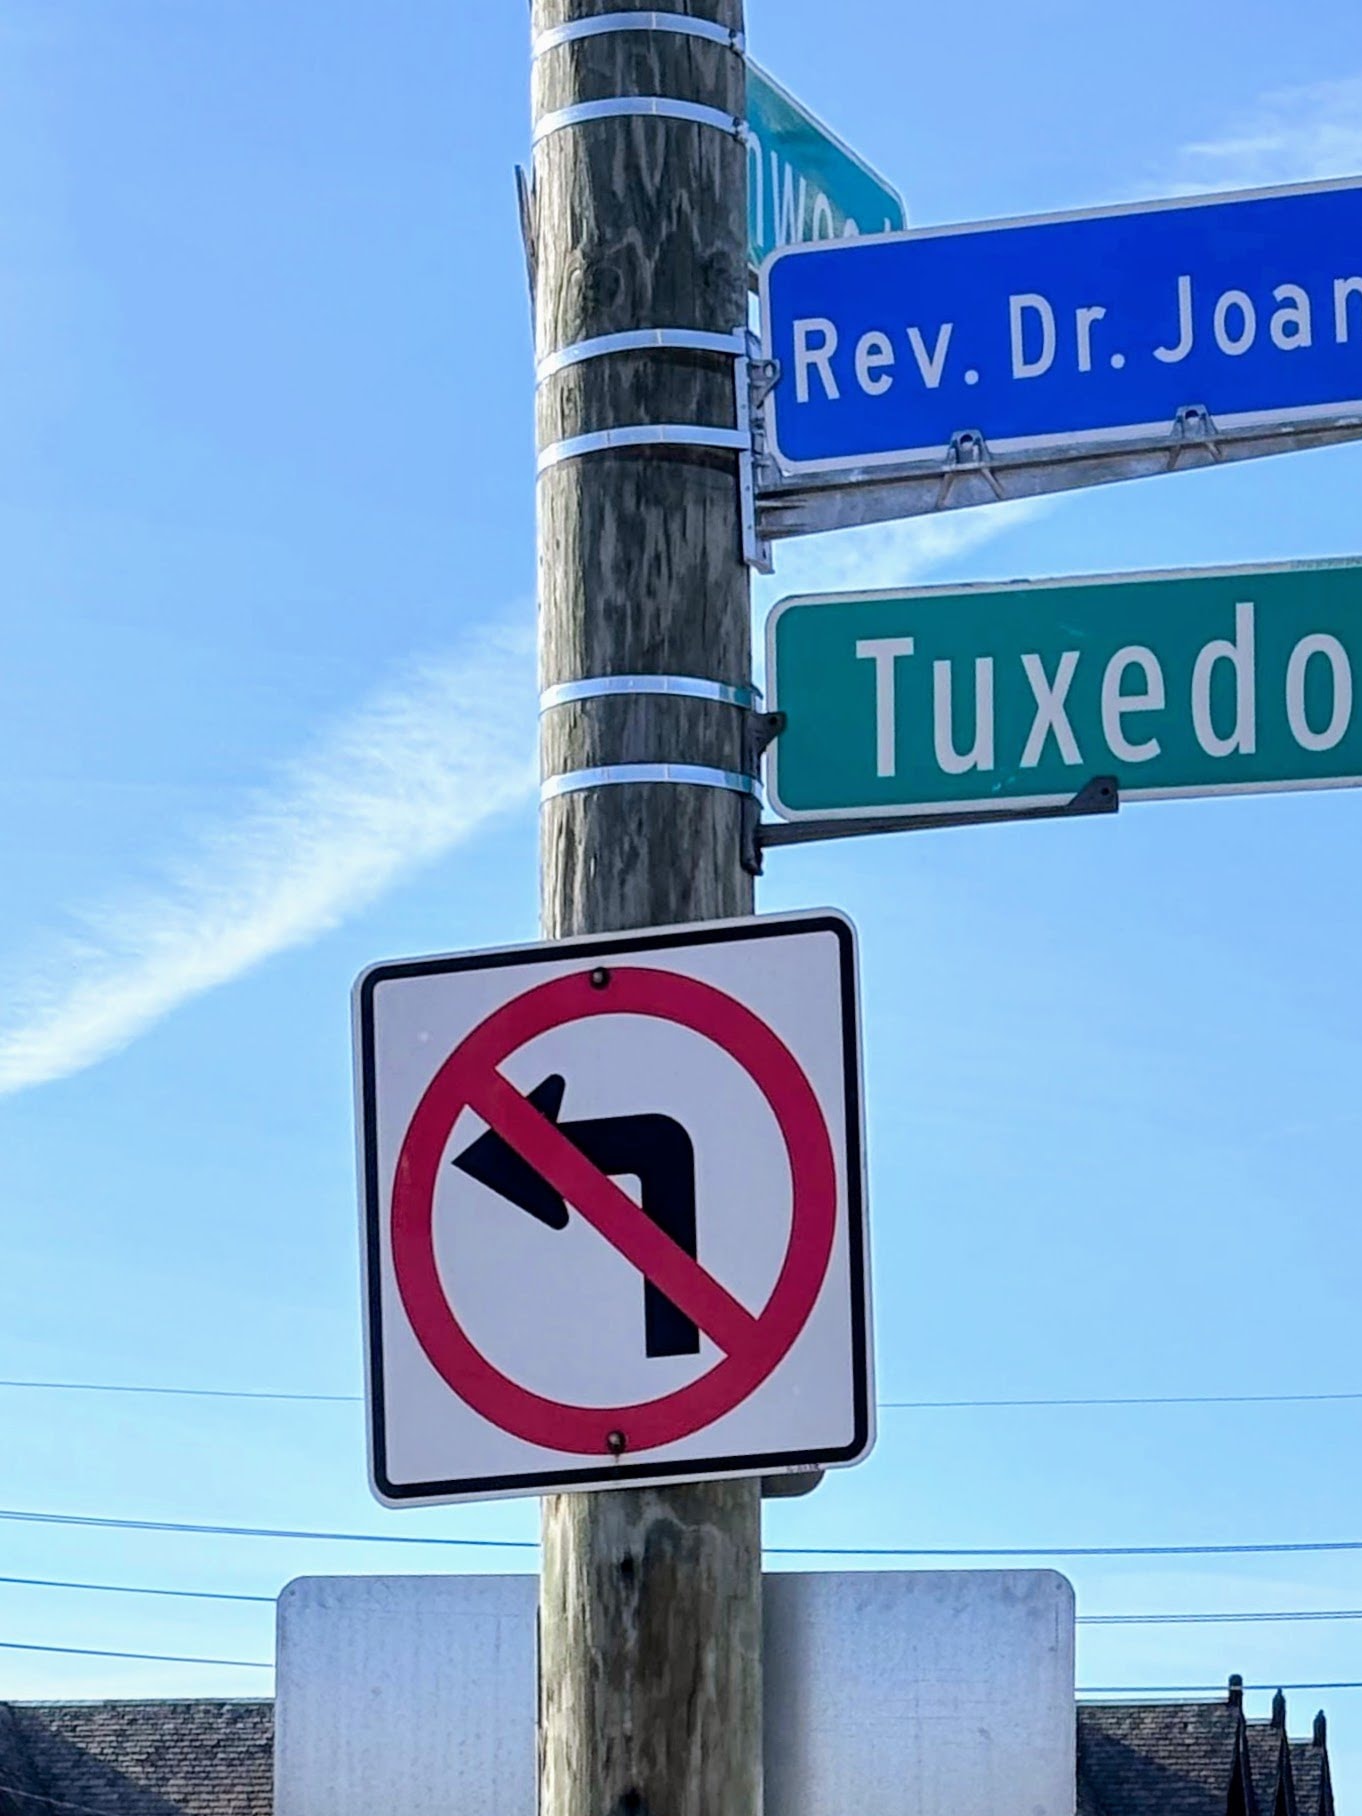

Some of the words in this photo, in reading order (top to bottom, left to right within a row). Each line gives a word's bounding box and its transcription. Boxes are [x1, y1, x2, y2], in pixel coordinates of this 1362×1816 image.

[792, 317, 979, 404] Rev.
[1008, 293, 1125, 381] Dr.
[856, 603, 1354, 779] Tuxedo
